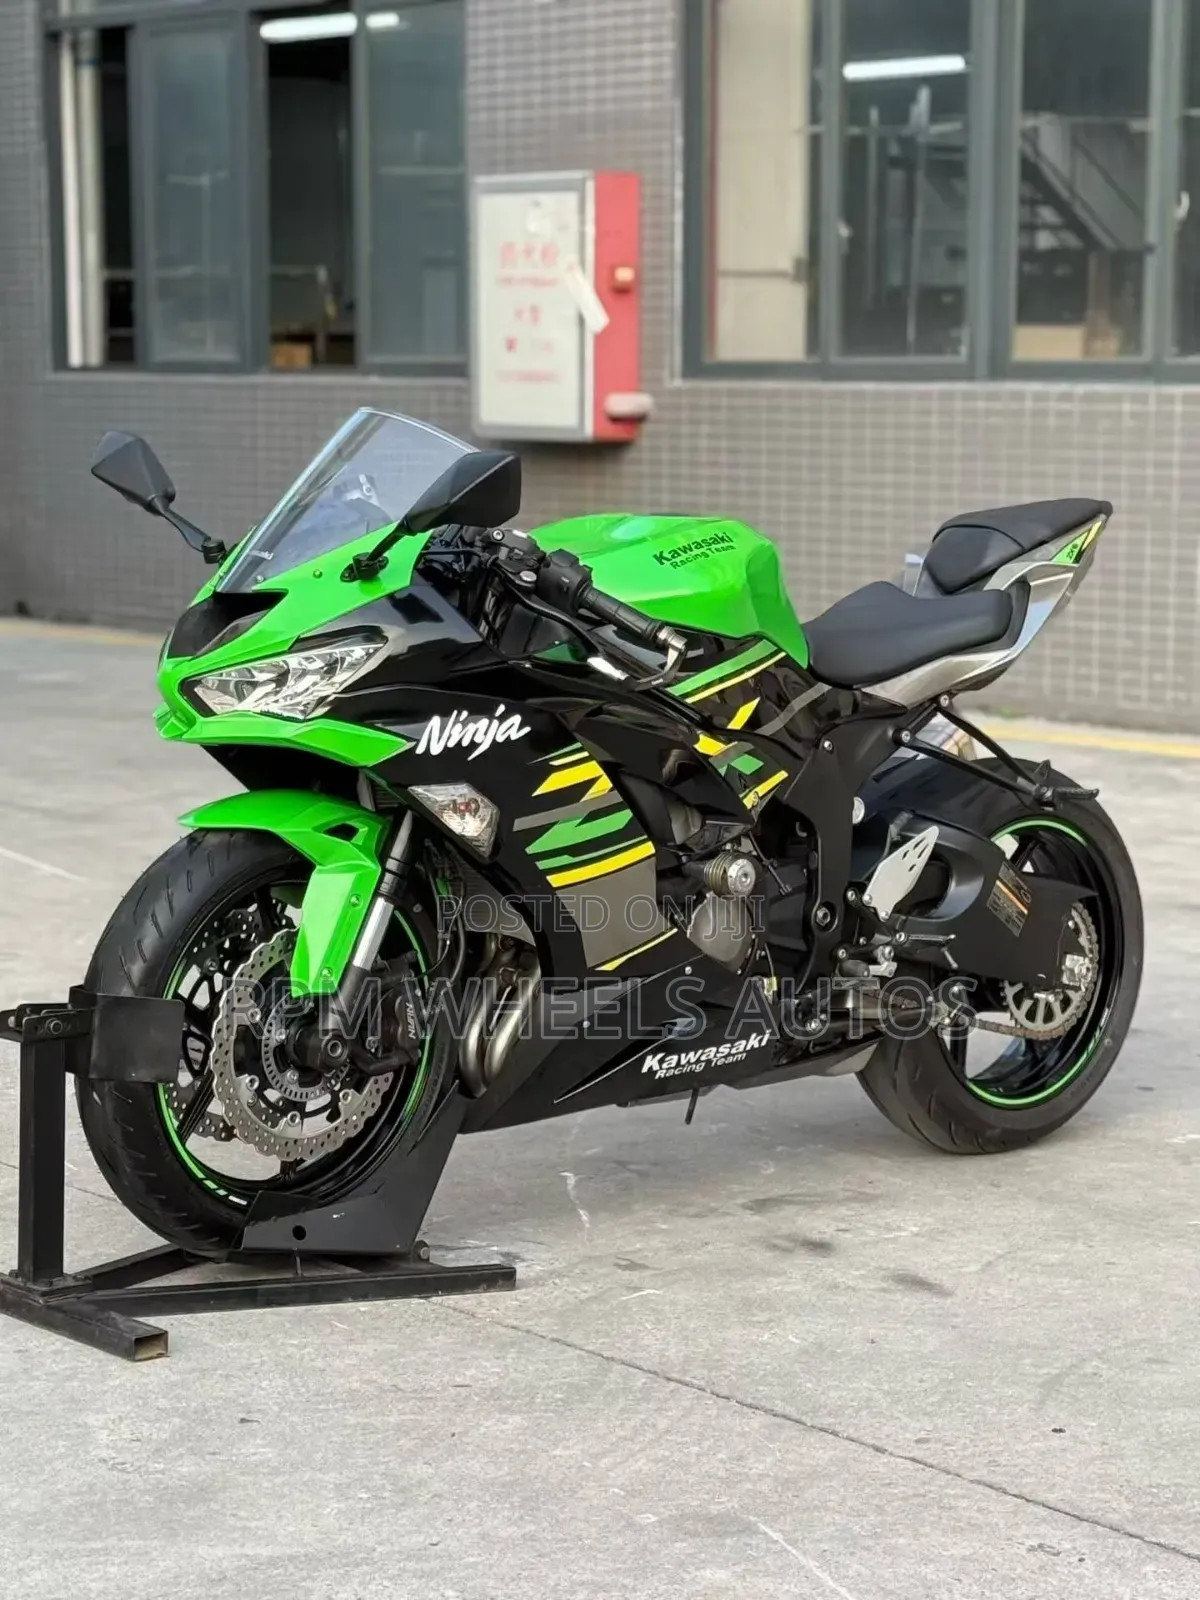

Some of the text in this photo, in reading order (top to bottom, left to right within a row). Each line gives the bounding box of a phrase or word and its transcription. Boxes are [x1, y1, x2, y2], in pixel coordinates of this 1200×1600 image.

[652, 532, 734, 566] Kawasaki
[670, 545, 736, 569] Racing Team
[415, 703, 532, 761] Ninja
[641, 1028, 773, 1073] Kawasaki
[654, 1052, 747, 1080] Racing Team
